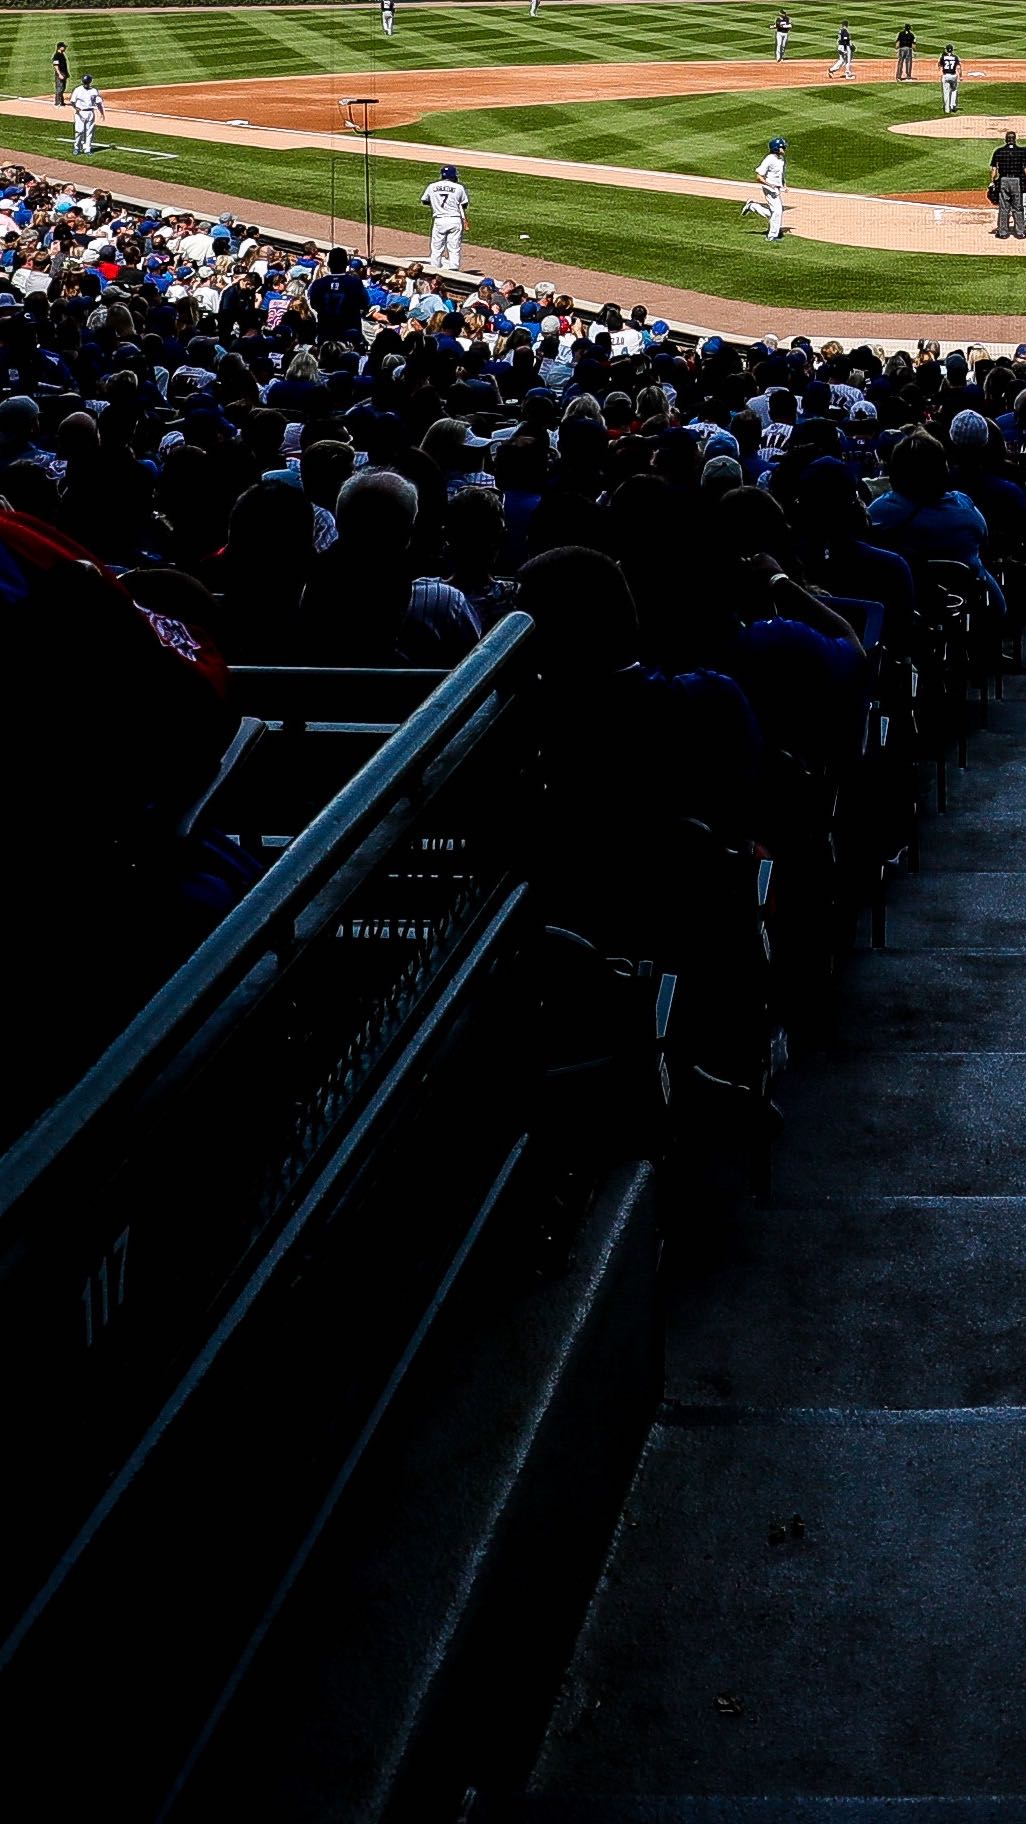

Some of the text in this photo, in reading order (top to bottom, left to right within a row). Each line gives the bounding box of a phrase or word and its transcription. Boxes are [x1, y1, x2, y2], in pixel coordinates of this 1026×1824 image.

[944, 60, 955, 69] 27
[439, 193, 449, 208] 7
[80, 1221, 131, 1349] 117
